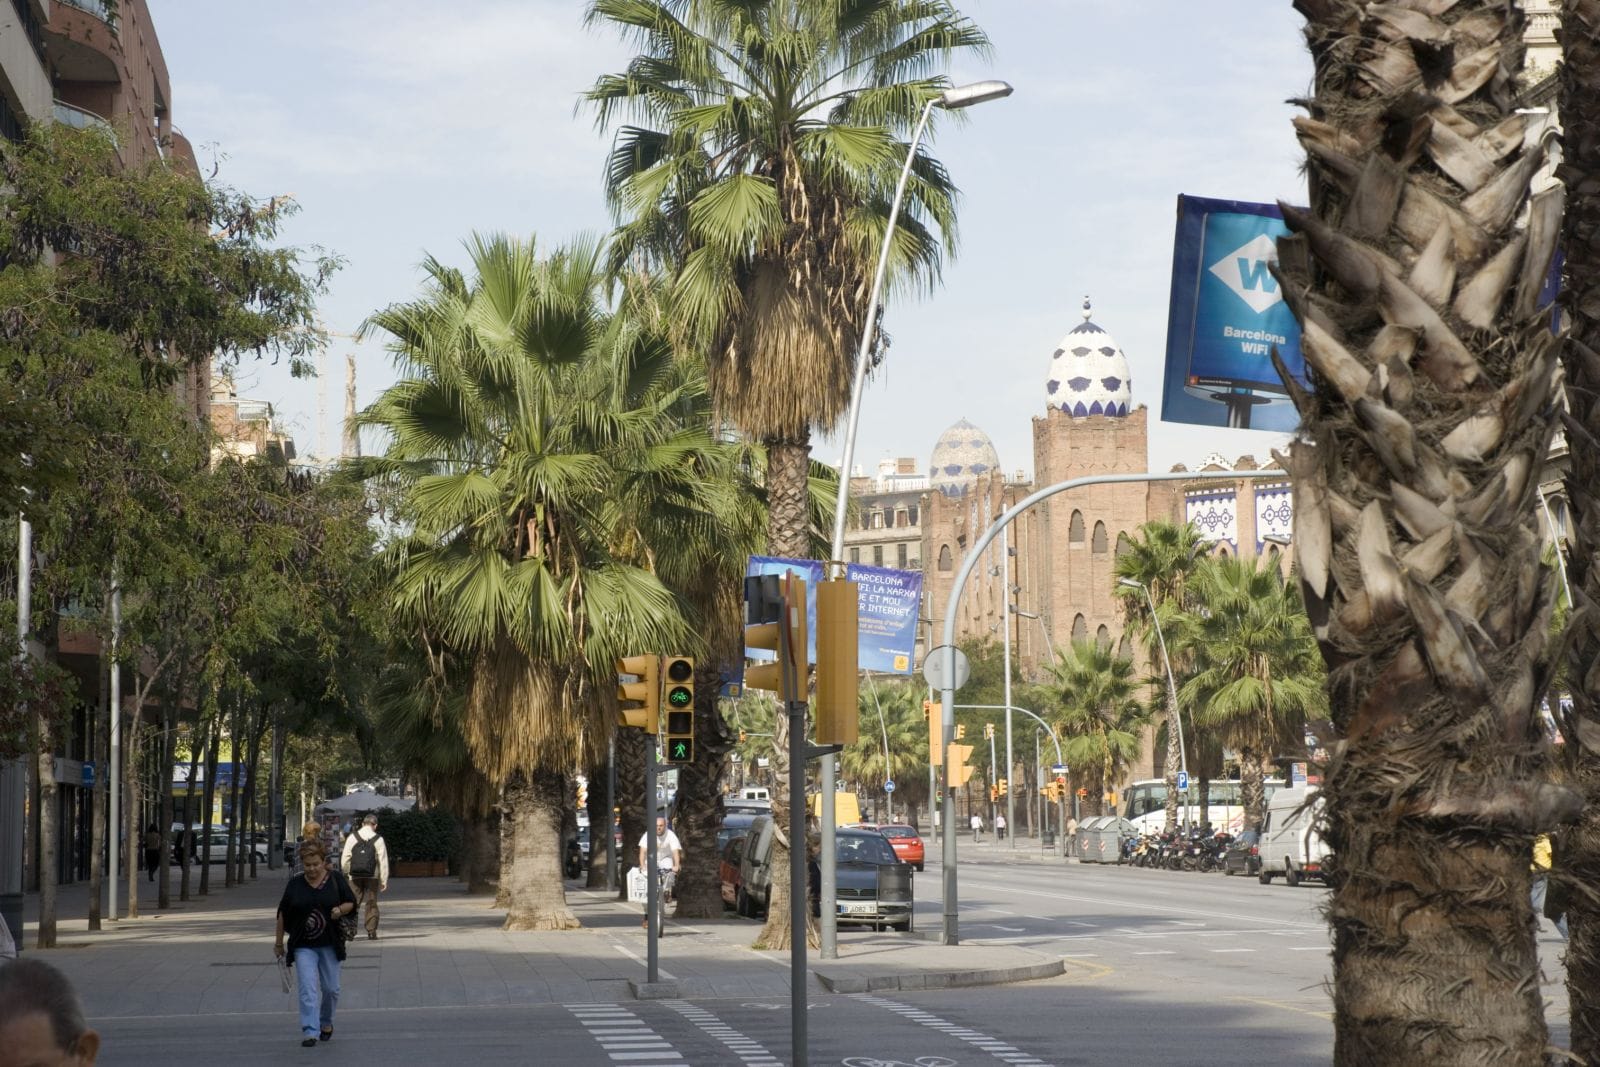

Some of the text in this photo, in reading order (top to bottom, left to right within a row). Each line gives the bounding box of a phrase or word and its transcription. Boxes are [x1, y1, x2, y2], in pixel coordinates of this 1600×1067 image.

[1237, 257, 1277, 293] W
[1223, 326, 1286, 345] Barcelona
[851, 572, 903, 587] BARCELONA
[873, 585, 885, 595] LA
[887, 587, 916, 599] XARXA
[869, 594, 880, 604] ET
[882, 596, 900, 606] MOU
[1179, 773, 1186, 787] P
